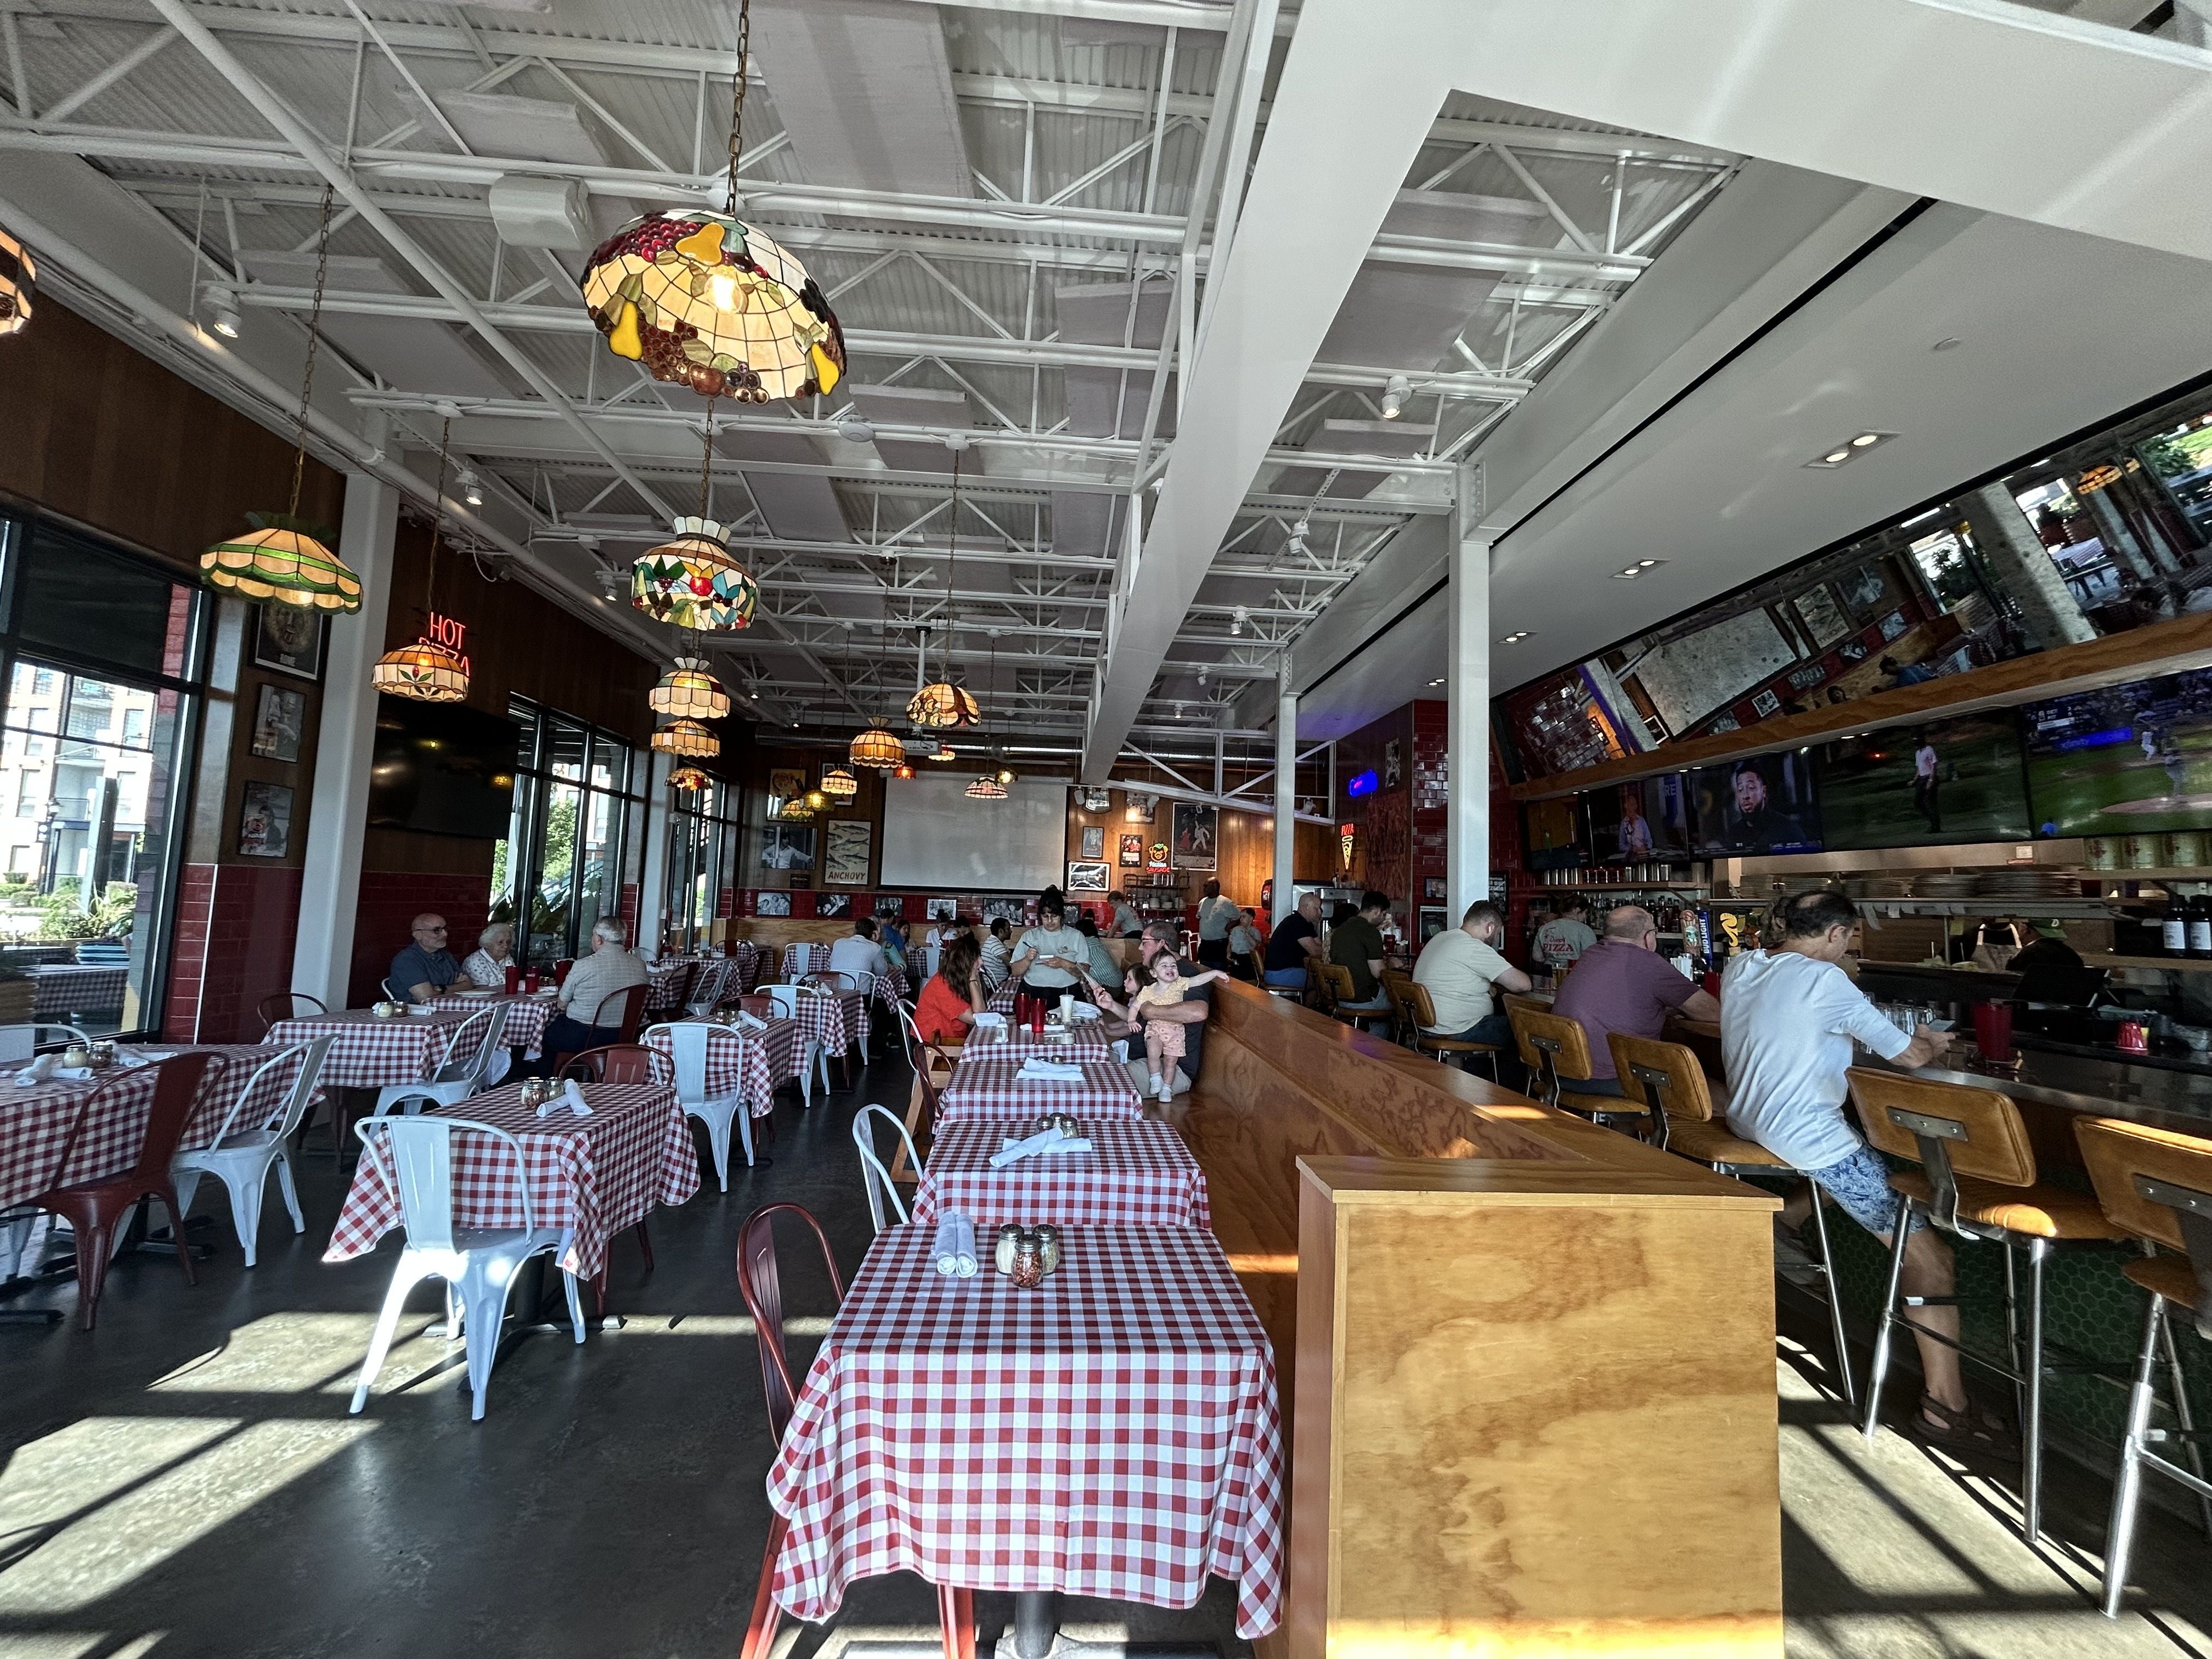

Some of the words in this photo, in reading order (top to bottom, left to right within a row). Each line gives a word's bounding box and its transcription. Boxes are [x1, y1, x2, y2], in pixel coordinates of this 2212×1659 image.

[430, 611, 466, 650] HOT
[1341, 823, 1354, 836] PIZZA
[827, 871, 866, 880] ANCHOVY
[1699, 918, 1708, 939] LIGHT
[1543, 944, 1573, 952] PIZZA
[1702, 940, 1710, 954] BUD
